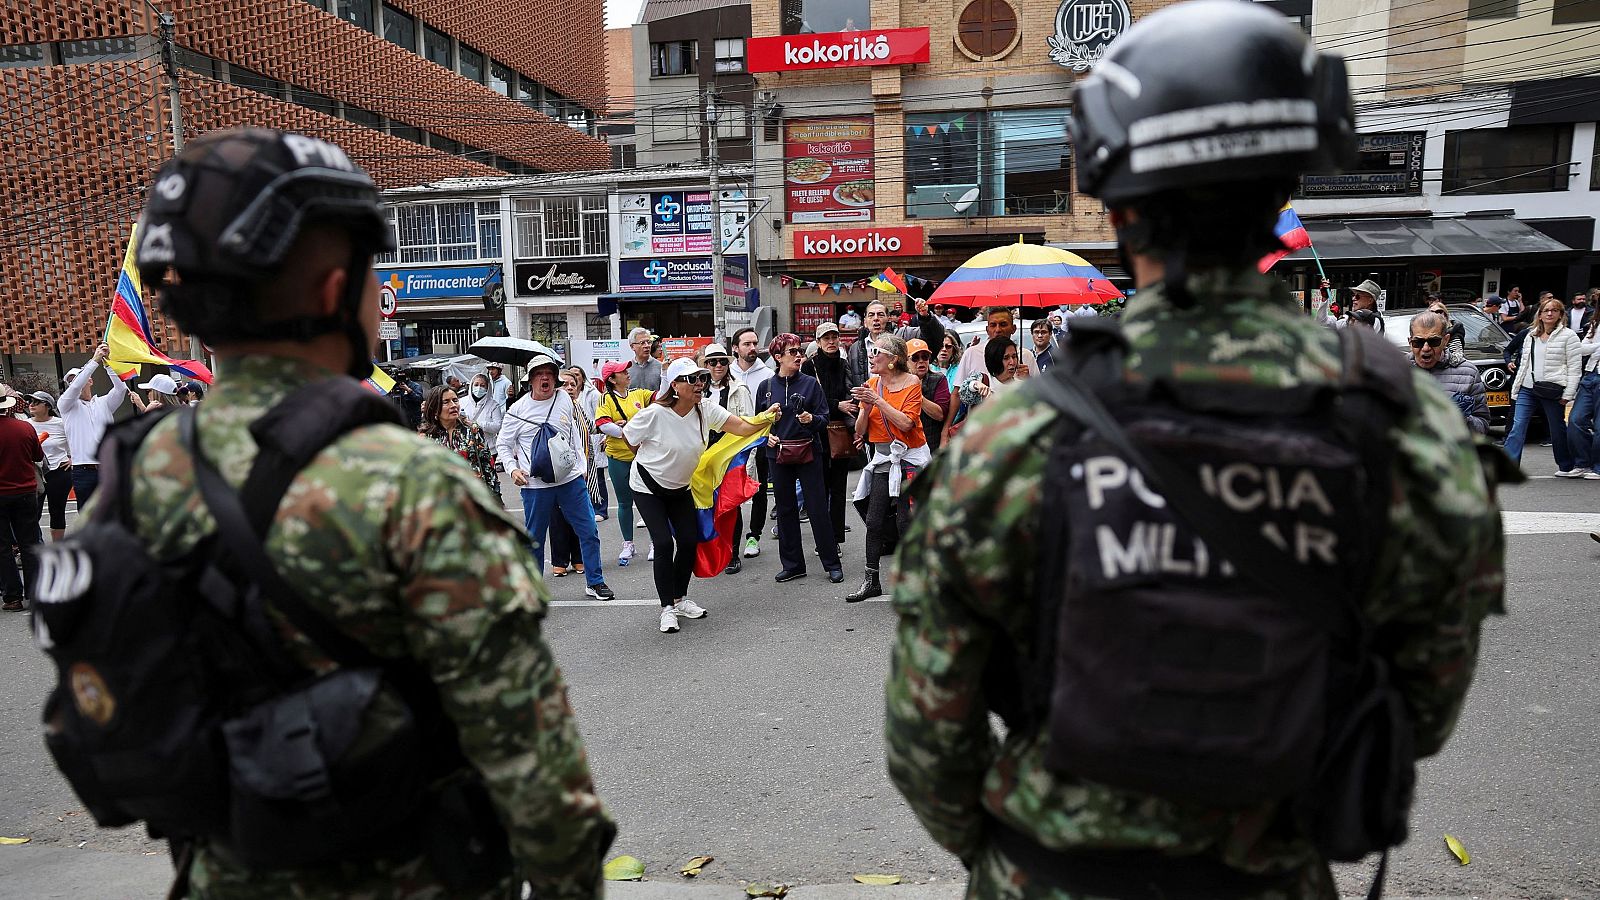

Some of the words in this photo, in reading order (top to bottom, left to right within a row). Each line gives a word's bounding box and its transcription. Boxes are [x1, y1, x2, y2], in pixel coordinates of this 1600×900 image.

[803, 232, 901, 254] kokoriko
[667, 261, 714, 271] Produsalu
[1085, 456, 1335, 515] PICIA
[1096, 521, 1340, 579] MILIR
